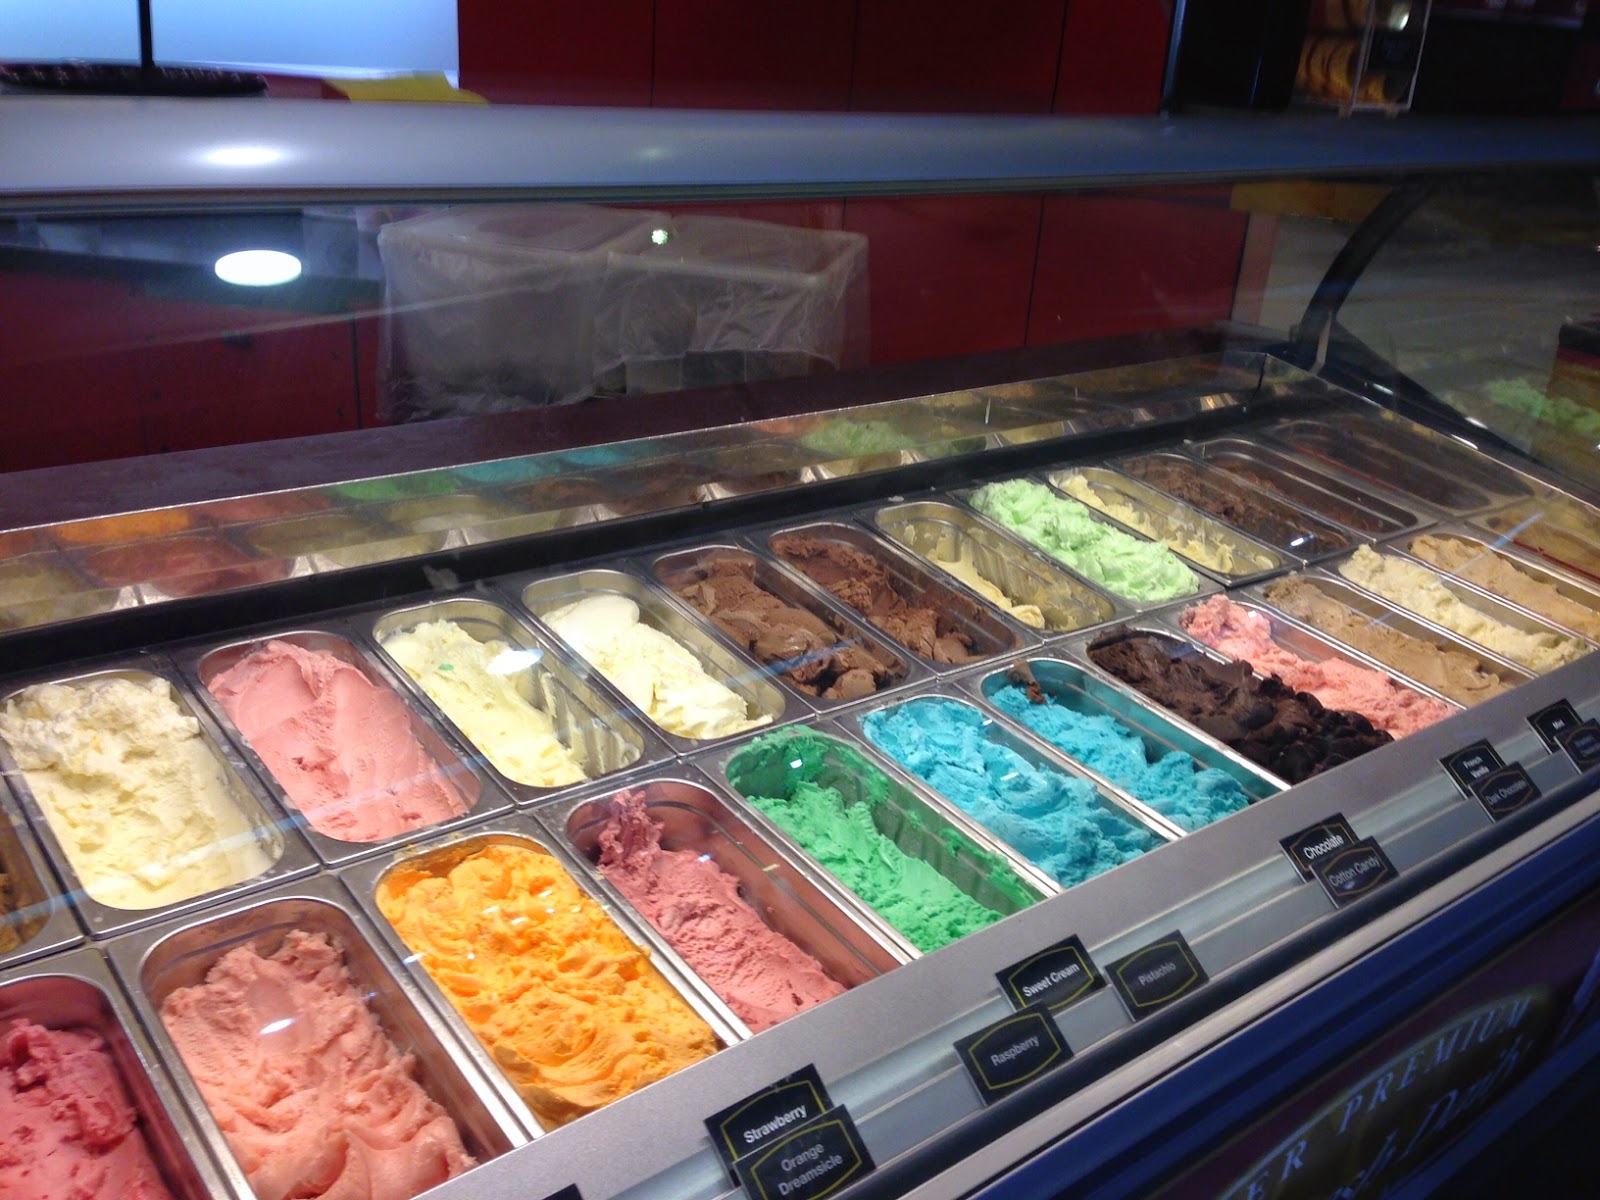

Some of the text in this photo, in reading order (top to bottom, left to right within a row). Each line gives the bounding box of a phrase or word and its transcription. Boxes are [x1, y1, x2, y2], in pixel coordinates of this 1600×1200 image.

[1485, 790, 1502, 806] Dark
[1303, 834, 1344, 860] Chocolate
[1328, 855, 1381, 887] Cotton Candy
[1022, 962, 1080, 998] Sweet Cream
[1137, 961, 1177, 986] Pistachio
[990, 1035, 1041, 1067] Raspberry
[1337, 996, 1533, 1136] PREMIUM
[743, 1104, 808, 1144] Strawberry
[780, 1143, 825, 1172] Orange
[777, 1154, 843, 1196] Dreamsicle
